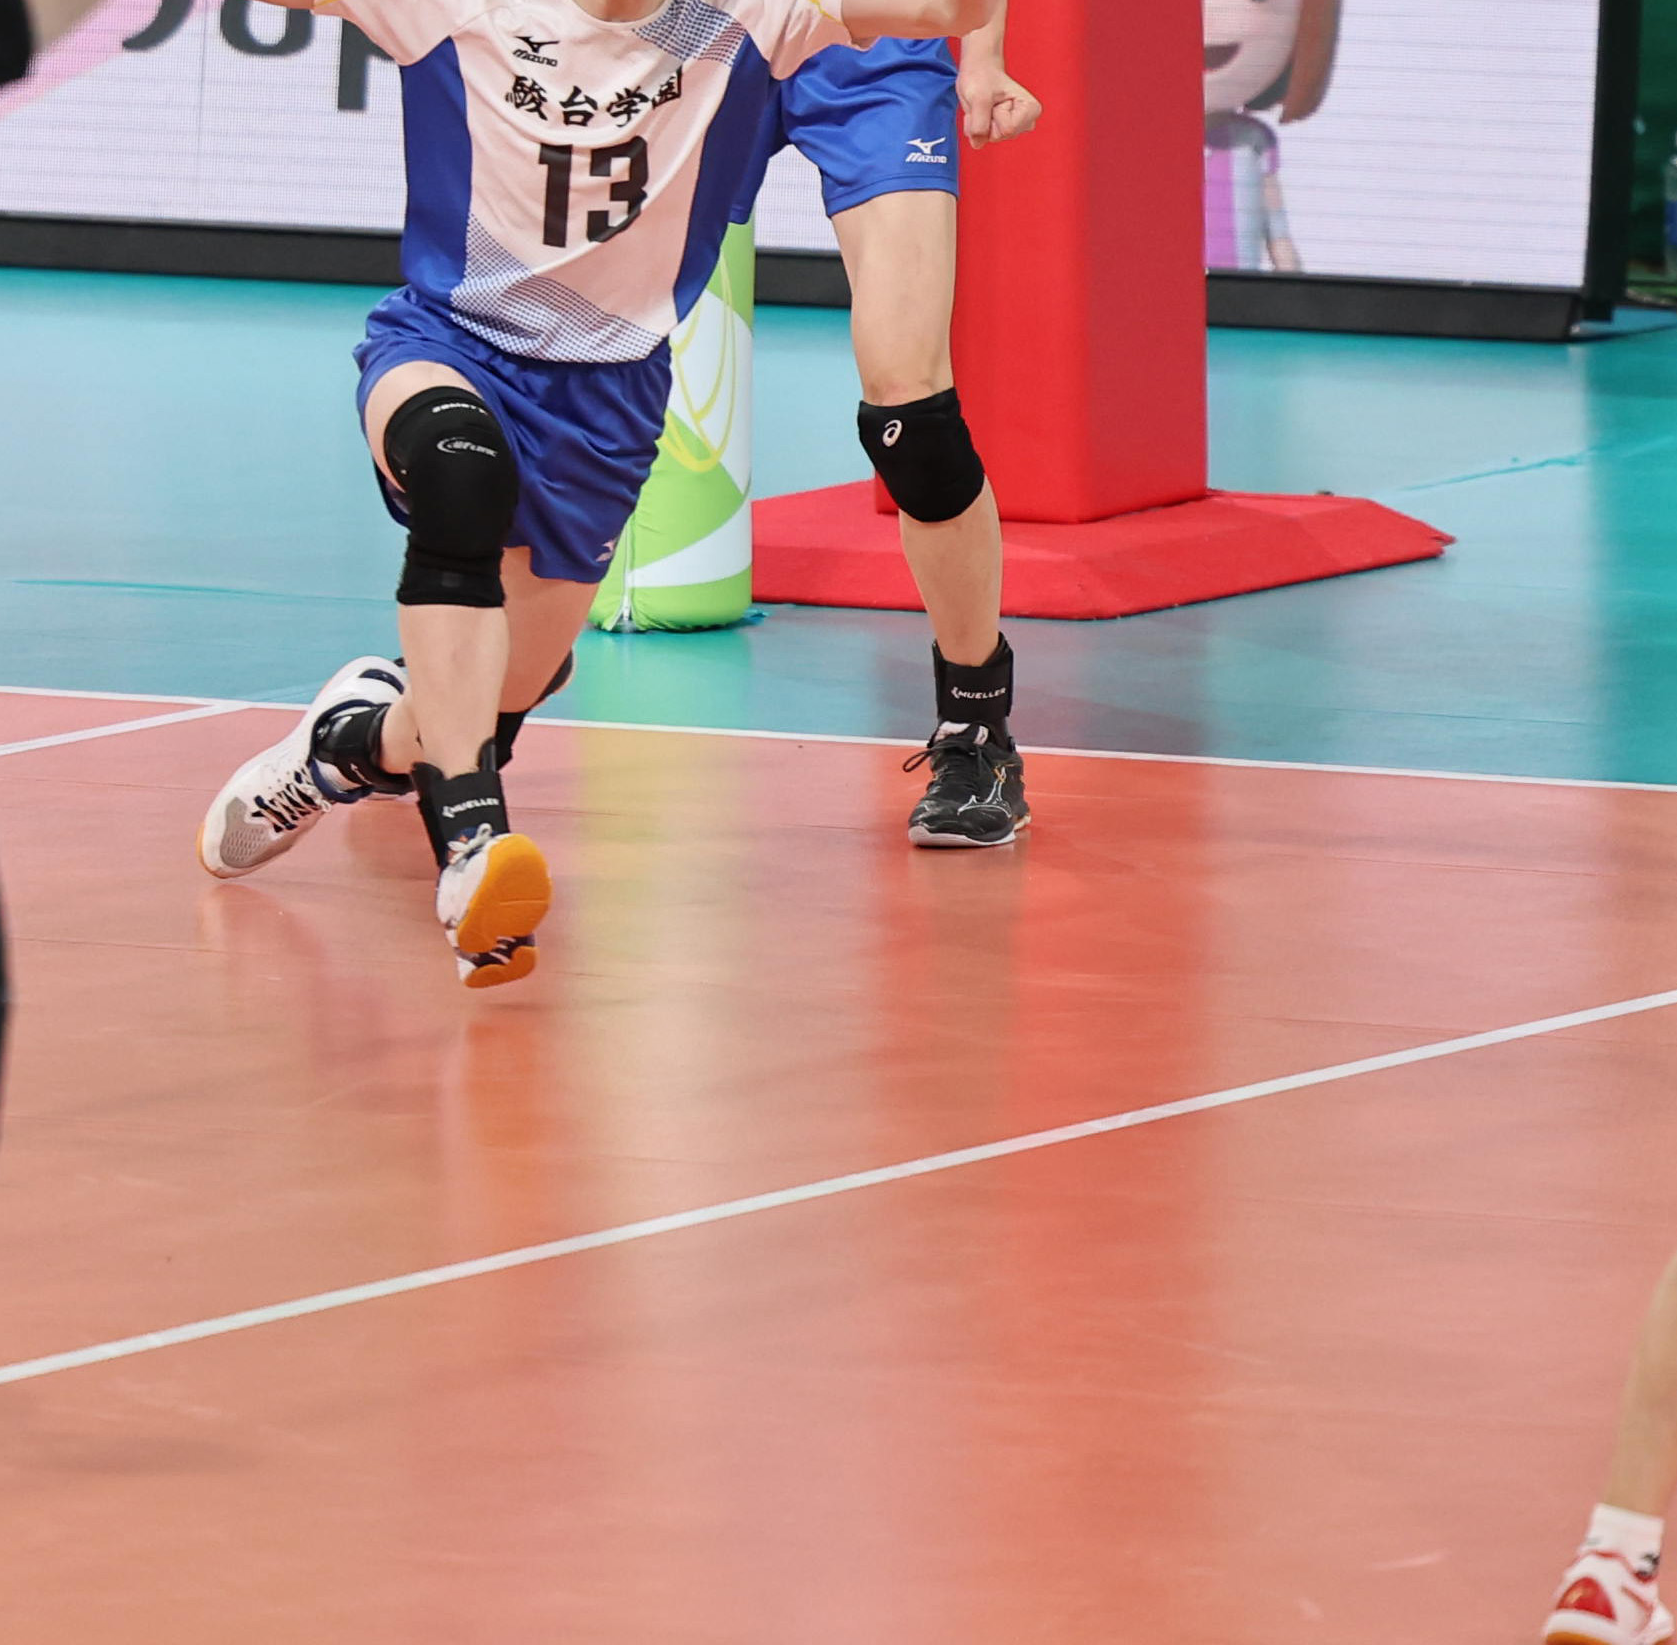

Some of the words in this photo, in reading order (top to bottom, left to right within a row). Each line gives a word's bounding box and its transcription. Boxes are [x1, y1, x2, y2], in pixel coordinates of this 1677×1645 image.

[504, 64, 684, 128] 駿台学園
[538, 135, 650, 249] 13
